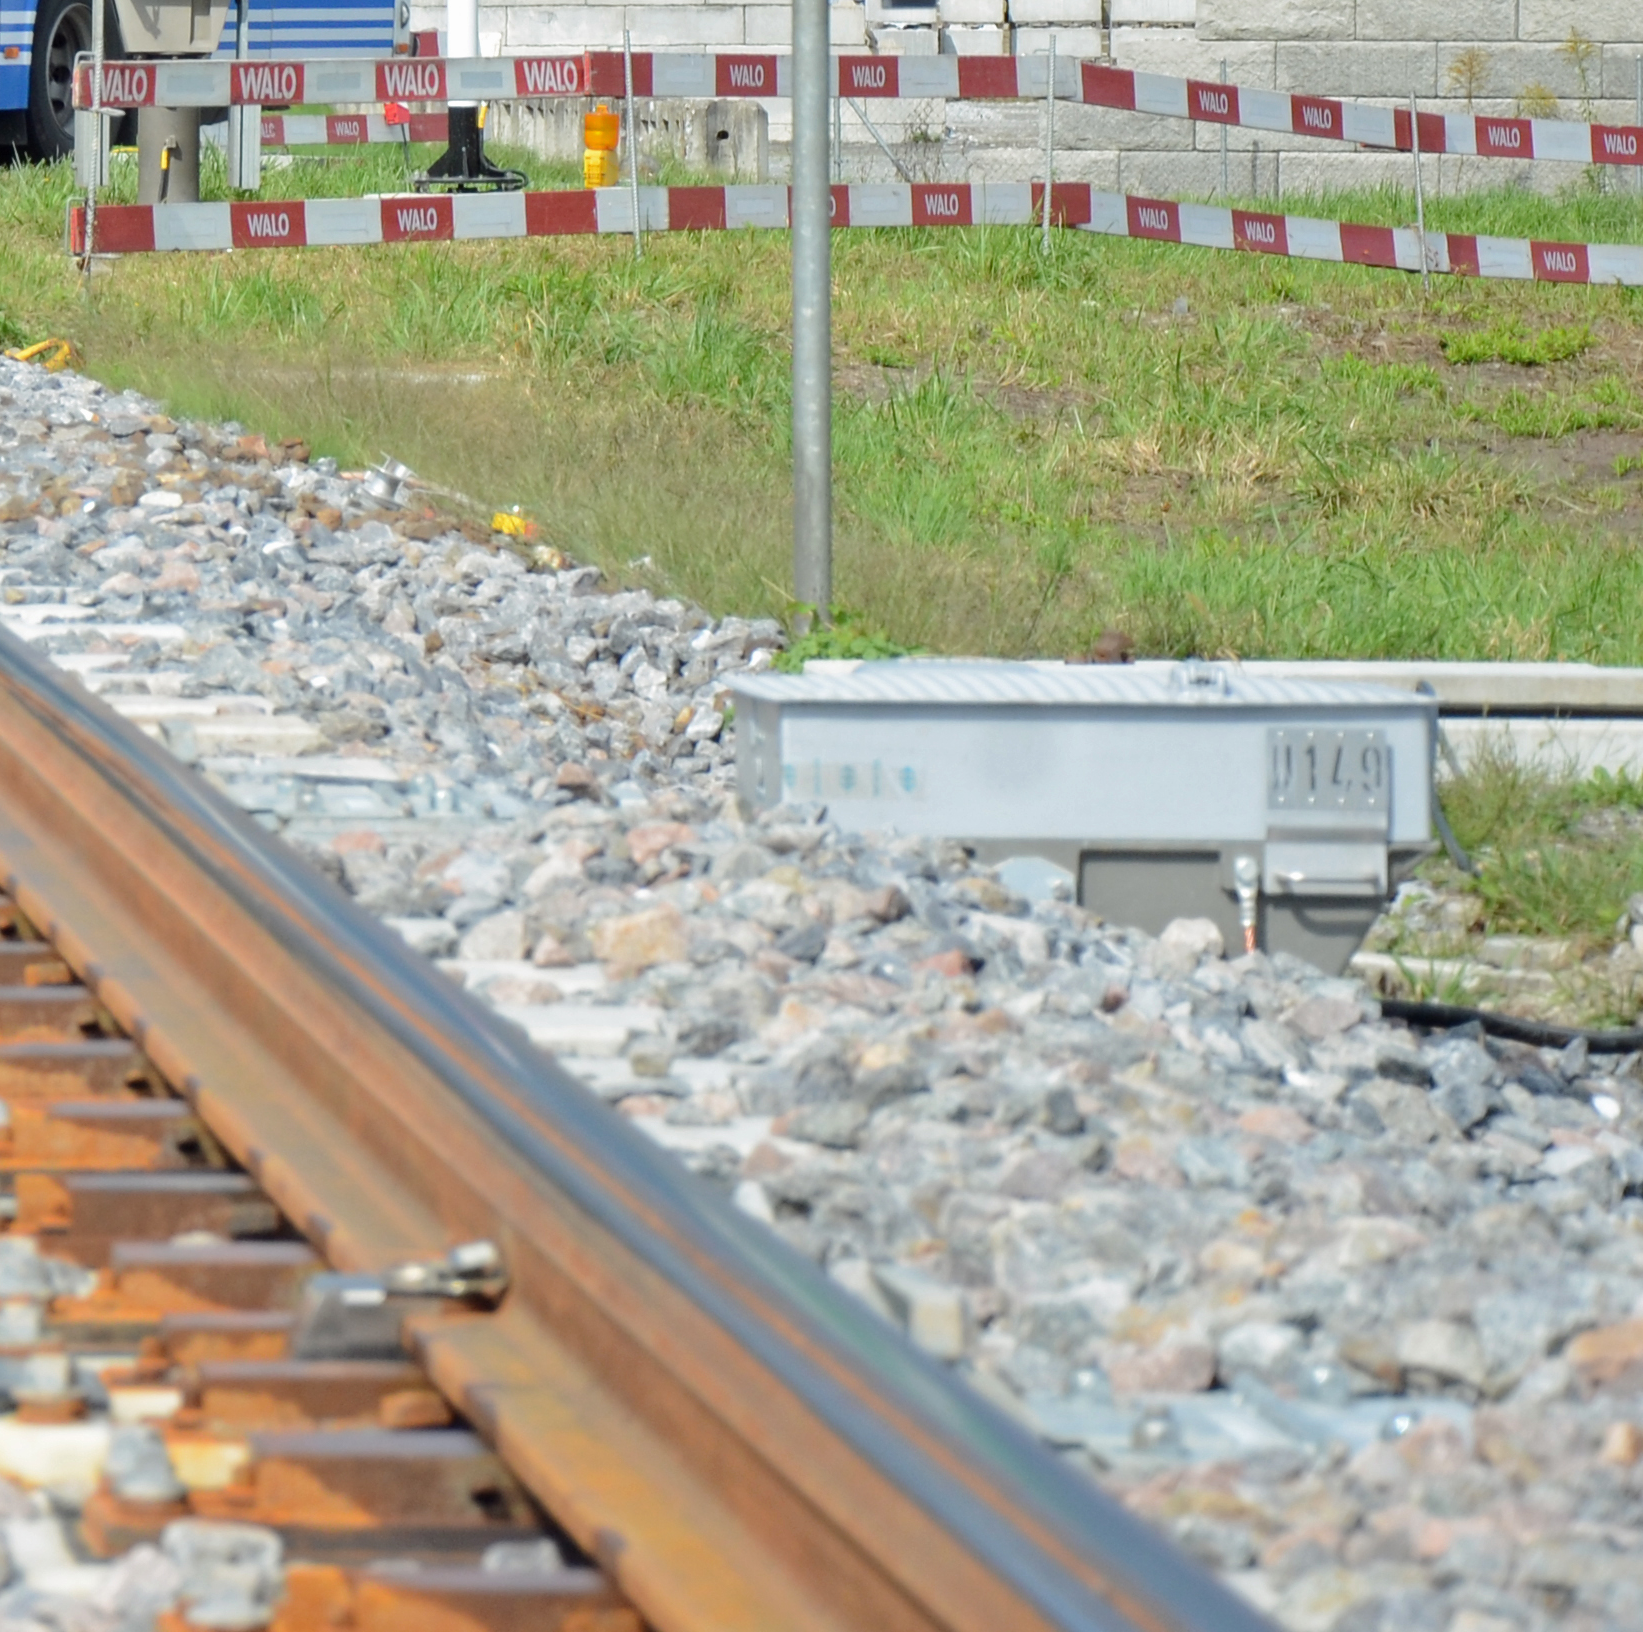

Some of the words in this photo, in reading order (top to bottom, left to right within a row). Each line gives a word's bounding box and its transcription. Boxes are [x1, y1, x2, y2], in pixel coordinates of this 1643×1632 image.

[89, 66, 149, 103] WALO
[239, 65, 297, 101] WALO
[384, 63, 440, 98] WALO
[522, 60, 579, 93] WALO
[730, 64, 765, 88] WALO
[852, 64, 886, 88] WALO
[1199, 90, 1228, 115] WALO
[334, 120, 360, 137] WALO
[1303, 105, 1332, 130] WALO
[1488, 124, 1521, 148] WALO
[1604, 132, 1637, 156] WALO
[925, 193, 959, 217] WALO
[247, 212, 290, 238] WALO
[397, 206, 438, 232] WALO
[1138, 205, 1169, 231] WALO
[1244, 219, 1275, 244] WALO
[1544, 250, 1576, 273] WALO
